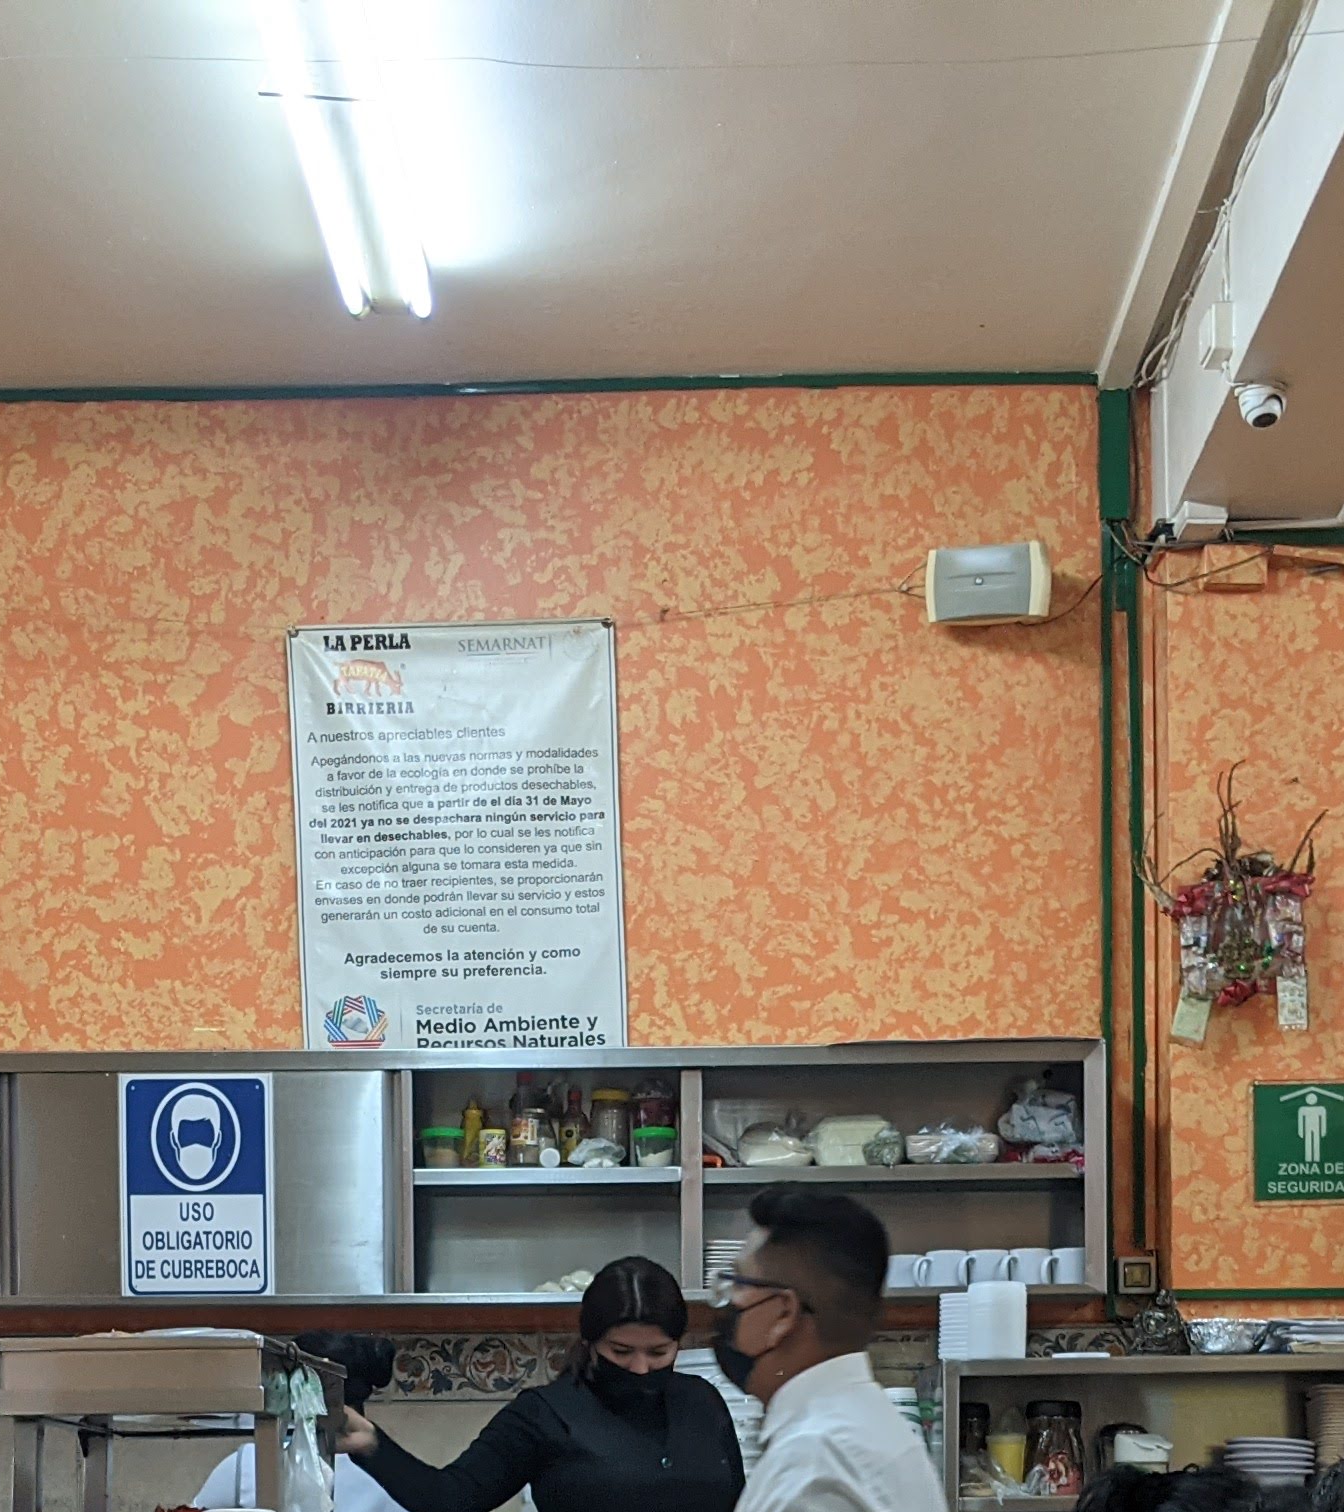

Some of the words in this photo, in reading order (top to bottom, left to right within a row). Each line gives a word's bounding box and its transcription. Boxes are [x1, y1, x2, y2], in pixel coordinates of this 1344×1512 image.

[323, 635, 346, 651] LA
[350, 633, 411, 651] PERLA
[458, 636, 546, 652] SEMARNAT
[326, 701, 414, 714] BIRRIERIA
[306, 732, 318, 743] A
[320, 730, 375, 743] nuestros
[378, 728, 452, 744] apreciables
[456, 727, 506, 739] clientes
[310, 751, 390, 768] Apegándonos
[392, 754, 400, 763] a
[403, 750, 420, 762] las
[424, 752, 466, 762] nuevas
[469, 751, 512, 760] normas
[516, 750, 523, 762] y
[526, 745, 599, 759] modalidades
[327, 772, 334, 780] a
[337, 768, 365, 780] favor
[368, 767, 383, 779] de
[386, 767, 396, 778] la
[452, 768, 468, 776] en
[470, 763, 507, 776] donde
[510, 766, 524, 775] se
[574, 761, 584, 773] la
[385, 786, 393, 797] y
[395, 781, 440, 797] entrega
[443, 781, 458, 793] de
[460, 779, 518, 795] productos
[521, 776, 596, 791] desechables,
[321, 803, 336, 812] se
[338, 800, 355, 811] les
[358, 799, 399, 811] notifica
[402, 801, 424, 812] que
[427, 800, 434, 808] a
[437, 796, 470, 811] partir
[472, 796, 487, 807] de
[490, 796, 501, 807] el
[504, 795, 522, 806] día
[526, 794, 538, 806] 31
[542, 794, 557, 805] de
[560, 793, 592, 807] Mayo
[308, 816, 328, 828] del
[330, 815, 357, 827] 2021
[360, 818, 375, 829] ya
[377, 817, 393, 826] no
[395, 817, 410, 825] se
[412, 812, 482, 827] despachara
[485, 810, 527, 825] ningún
[530, 809, 577, 821] servicio
[579, 811, 606, 822] para
[320, 831, 354, 843] llevar
[356, 834, 371, 842] en
[374, 828, 451, 843] desechables,
[454, 831, 474, 842] por
[476, 827, 488, 839] lo
[490, 826, 514, 838] cual
[517, 829, 532, 837] se
[534, 825, 552, 837] les
[554, 824, 595, 836] notifica
[314, 850, 336, 859] con
[338, 845, 406, 861] anticipación
[409, 847, 436, 859] para
[438, 846, 461, 858] que
[464, 843, 475, 855] lo
[477, 841, 541, 854] consideren
[543, 843, 558, 855] ya
[560, 843, 582, 855] que
[585, 839, 602, 851] sin
[340, 861, 399, 877] excepción
[402, 860, 440, 875] alguna
[443, 862, 458, 871] se
[460, 858, 501, 870] tomara
[504, 857, 529, 869] esta
[532, 856, 577, 868] medida.
[315, 879, 332, 890] En
[335, 881, 363, 889] caso
[365, 877, 381, 889] de
[384, 880, 398, 888] no
[401, 876, 428, 888] traer
[430, 874, 497, 889] recipientes,
[500, 876, 514, 885] se
[517, 870, 604, 887] proporcionarán
[314, 896, 364, 906] envases
[366, 896, 381, 904] en
[384, 891, 421, 904] donde
[423, 890, 464, 905] podrán
[466, 889, 498, 901] llevar
[500, 892, 515, 900] su
[517, 887, 562, 900] servicio
[564, 890, 572, 901] y
[574, 886, 606, 898] estos
[320, 908, 380, 924] generarán
[383, 911, 398, 919] un
[401, 906, 432, 919] costo
[435, 905, 486, 918] adicional
[489, 907, 504, 916] en
[507, 904, 518, 916] el
[520, 905, 573, 915] consumo
[575, 901, 600, 914] total
[423, 922, 438, 934] de
[440, 925, 455, 933] su
[457, 920, 500, 933] cuenta.
[344, 949, 443, 967] Agradecemos
[447, 949, 460, 961] la
[463, 947, 525, 961] atención
[528, 950, 537, 962] y
[541, 948, 581, 958] como
[380, 965, 436, 982] siempre
[442, 968, 458, 977] su
[463, 962, 548, 980] preferencia.
[416, 1002, 484, 1015] Secretaría
[486, 1003, 504, 1014] de
[416, 1018, 477, 1034] Medio
[483, 1015, 580, 1033] Ambiente
[586, 1016, 598, 1031] y
[512, 1032, 606, 1048] Naturales
[1278, 1163, 1320, 1176] ZONA
[1324, 1162, 1344, 1175] DE
[179, 1202, 214, 1222] USO
[142, 1230, 253, 1250] OBLIGATORIO
[135, 1260, 156, 1279] DE
[160, 1259, 261, 1279] CUBREBOCA
